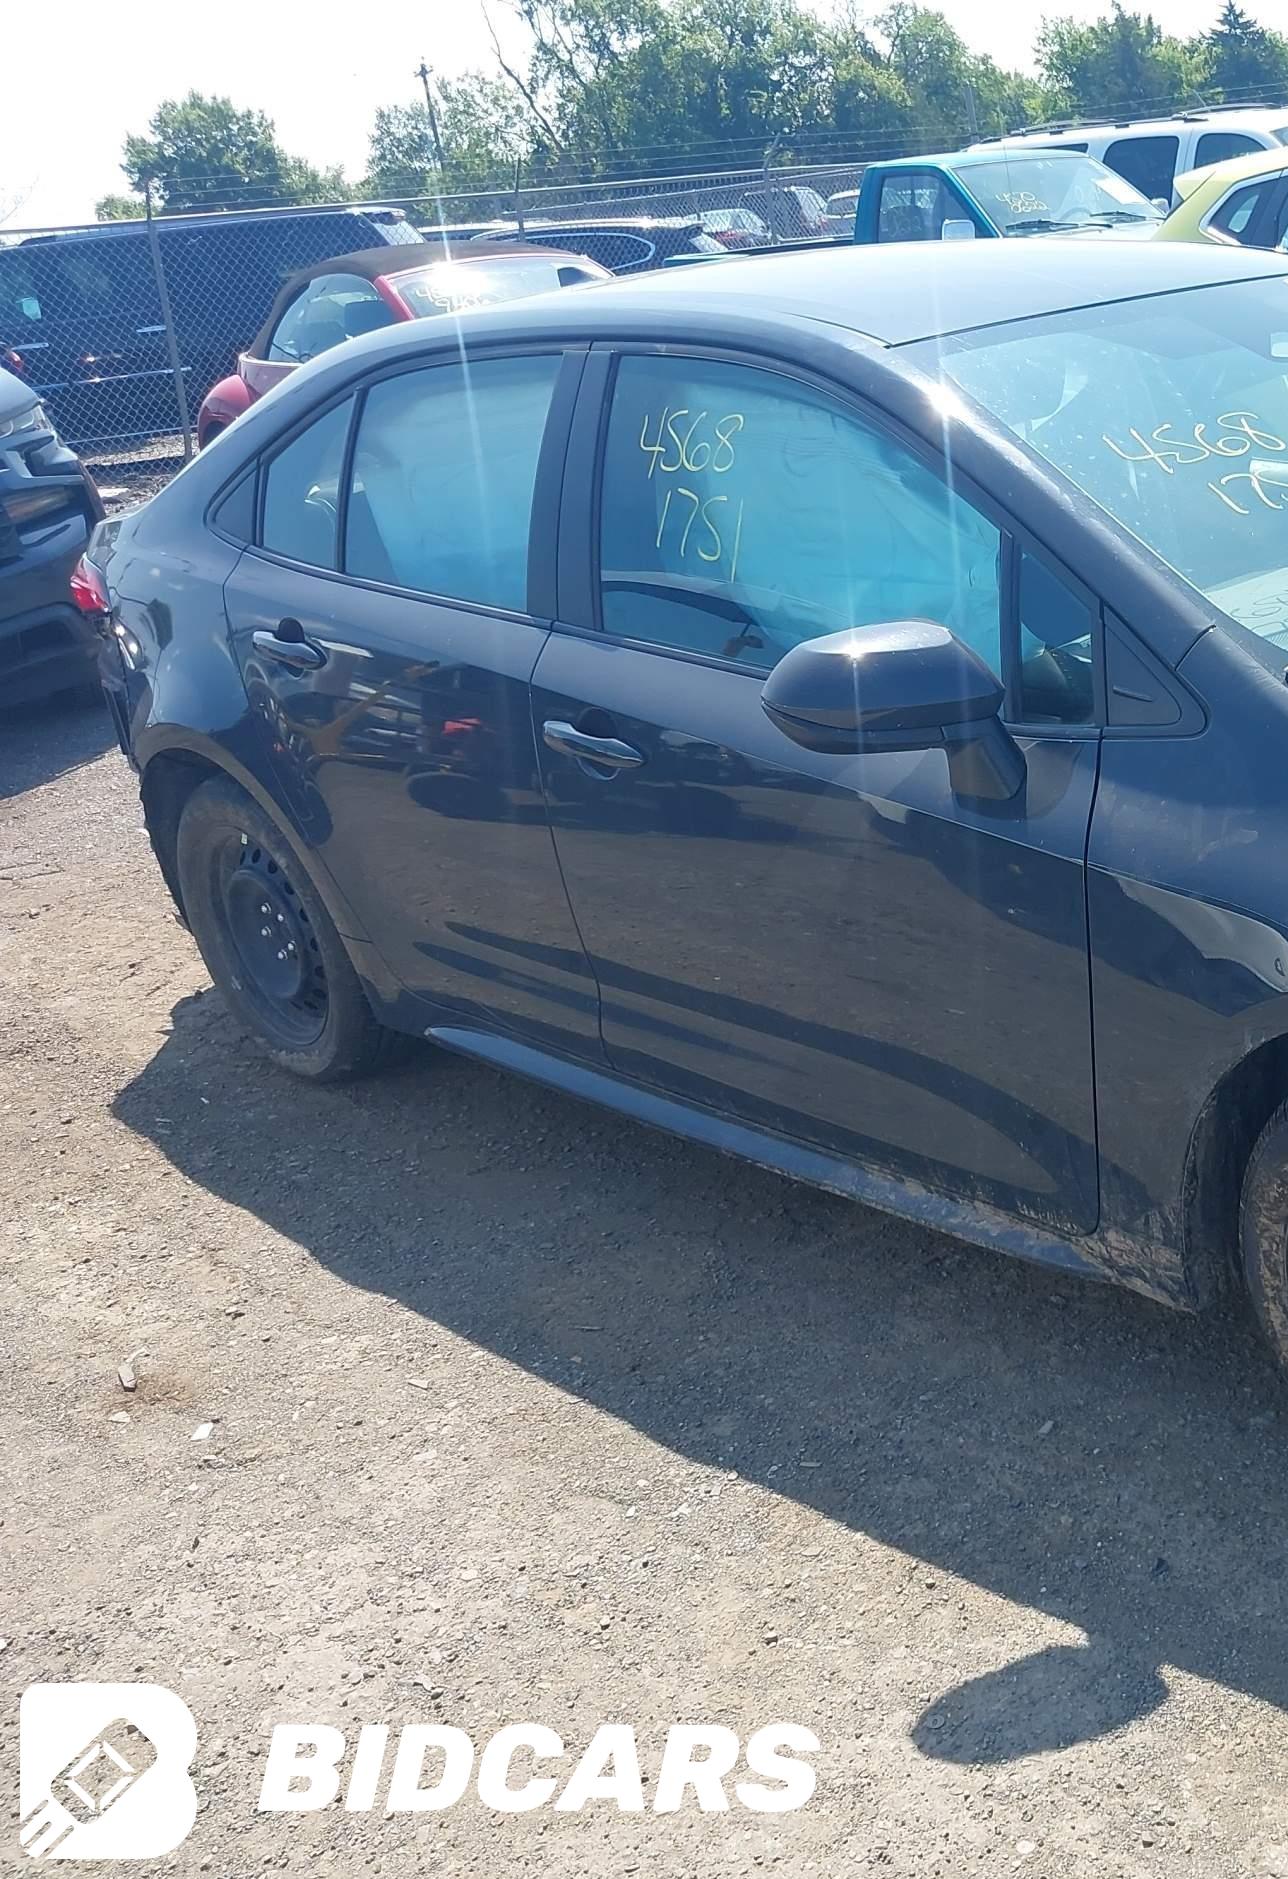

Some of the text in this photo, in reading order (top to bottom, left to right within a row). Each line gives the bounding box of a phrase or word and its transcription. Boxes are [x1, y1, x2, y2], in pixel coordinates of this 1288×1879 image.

[640, 407, 744, 480] 4568
[1101, 411, 1287, 474] 4568
[656, 487, 744, 583] 1751
